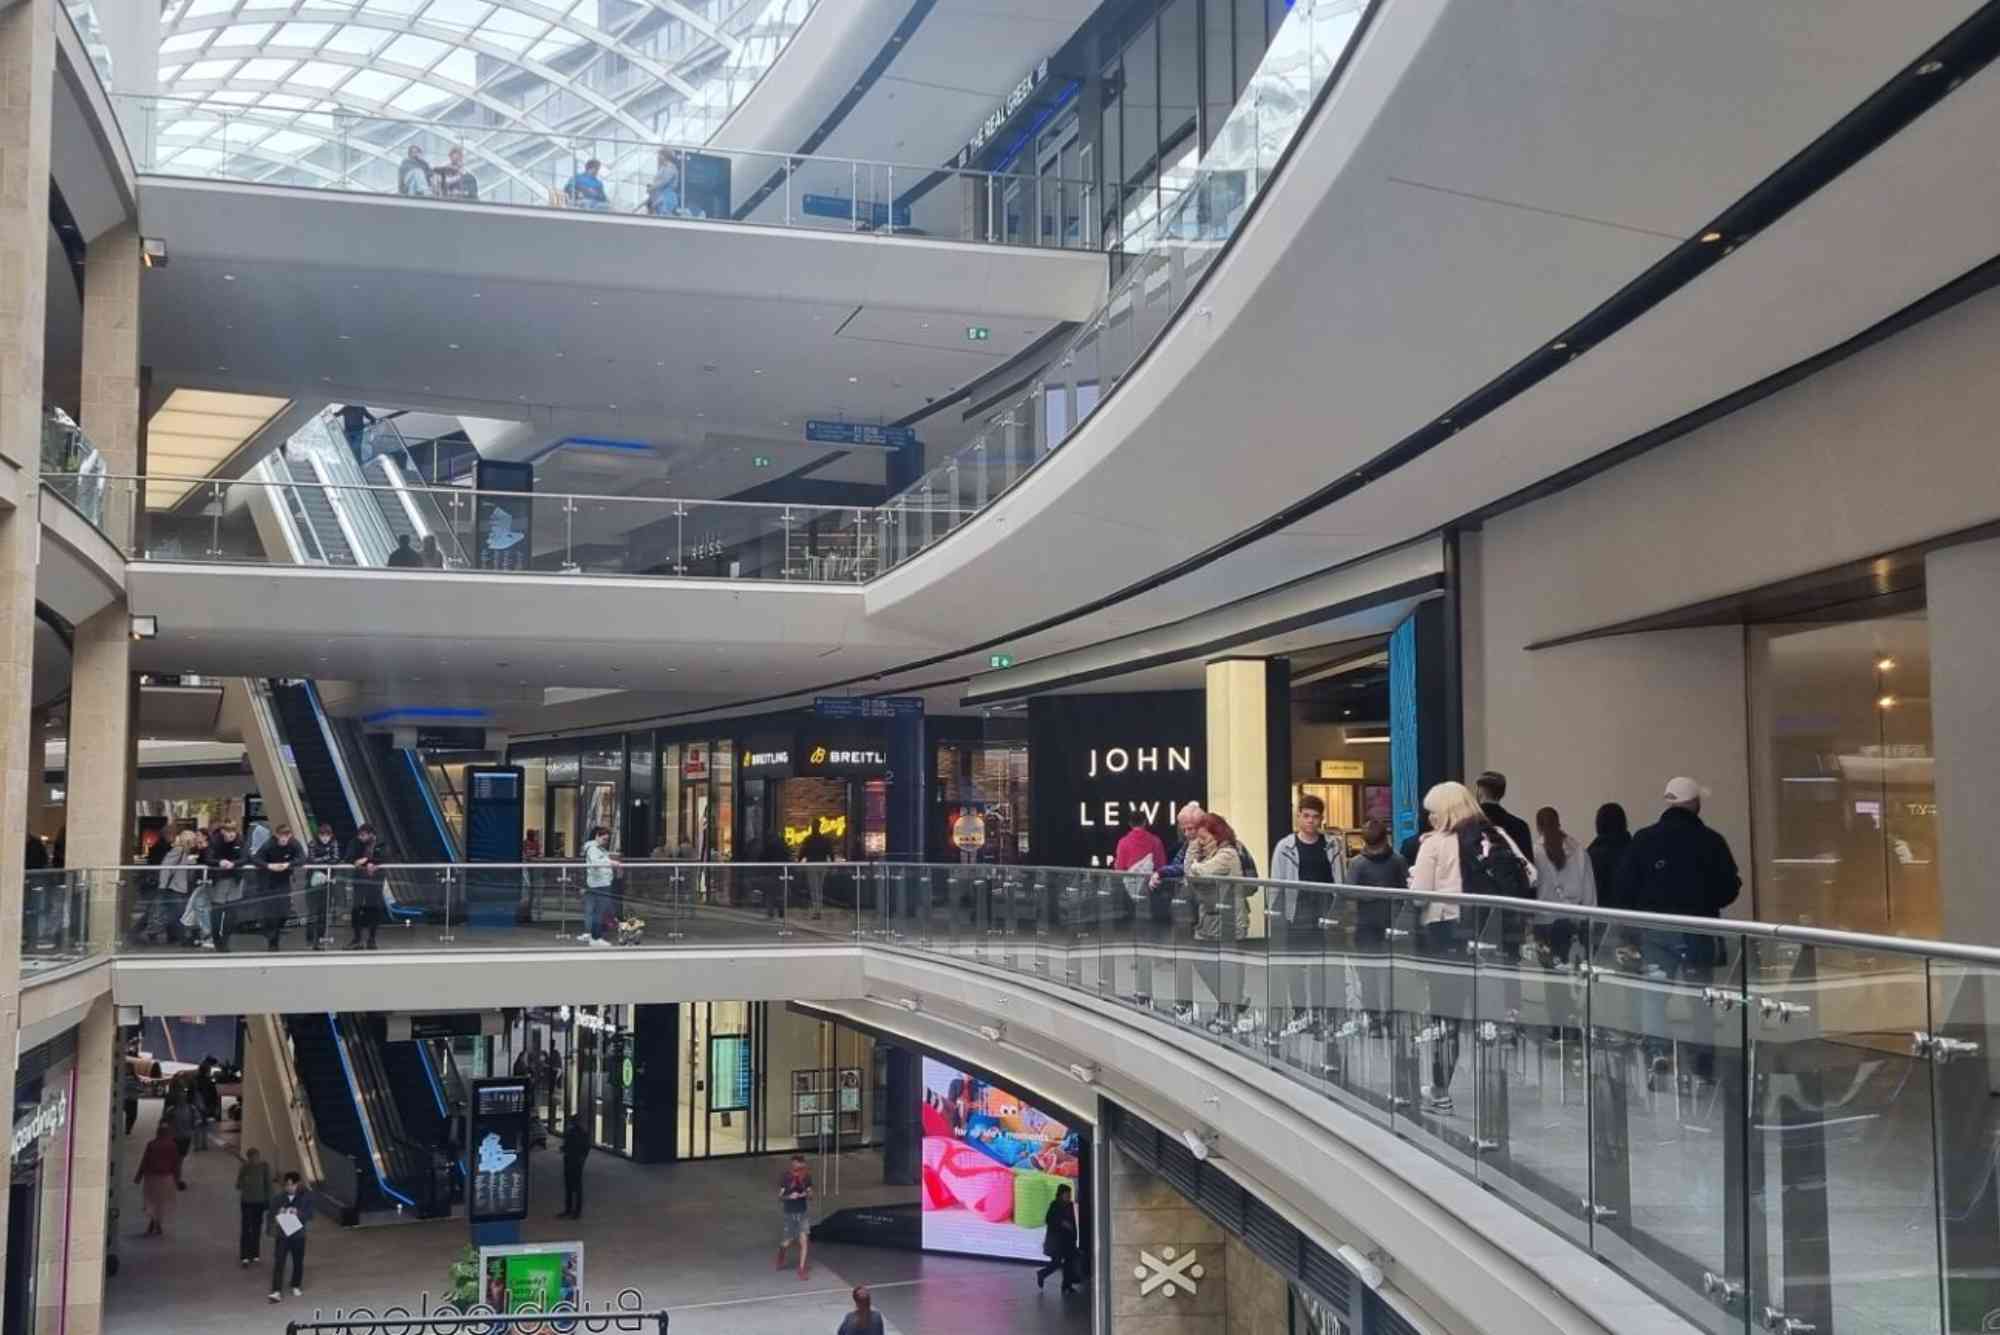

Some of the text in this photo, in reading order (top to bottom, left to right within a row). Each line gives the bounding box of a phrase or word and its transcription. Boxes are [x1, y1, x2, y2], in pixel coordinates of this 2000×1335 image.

[984, 105, 1007, 138] REAL
[1007, 71, 1034, 116] GREEK
[751, 752, 790, 767] BREITLING
[1087, 747, 1191, 777] JOHN
[1080, 801, 1200, 827] LEWI
[954, 1126, 967, 1137] for
